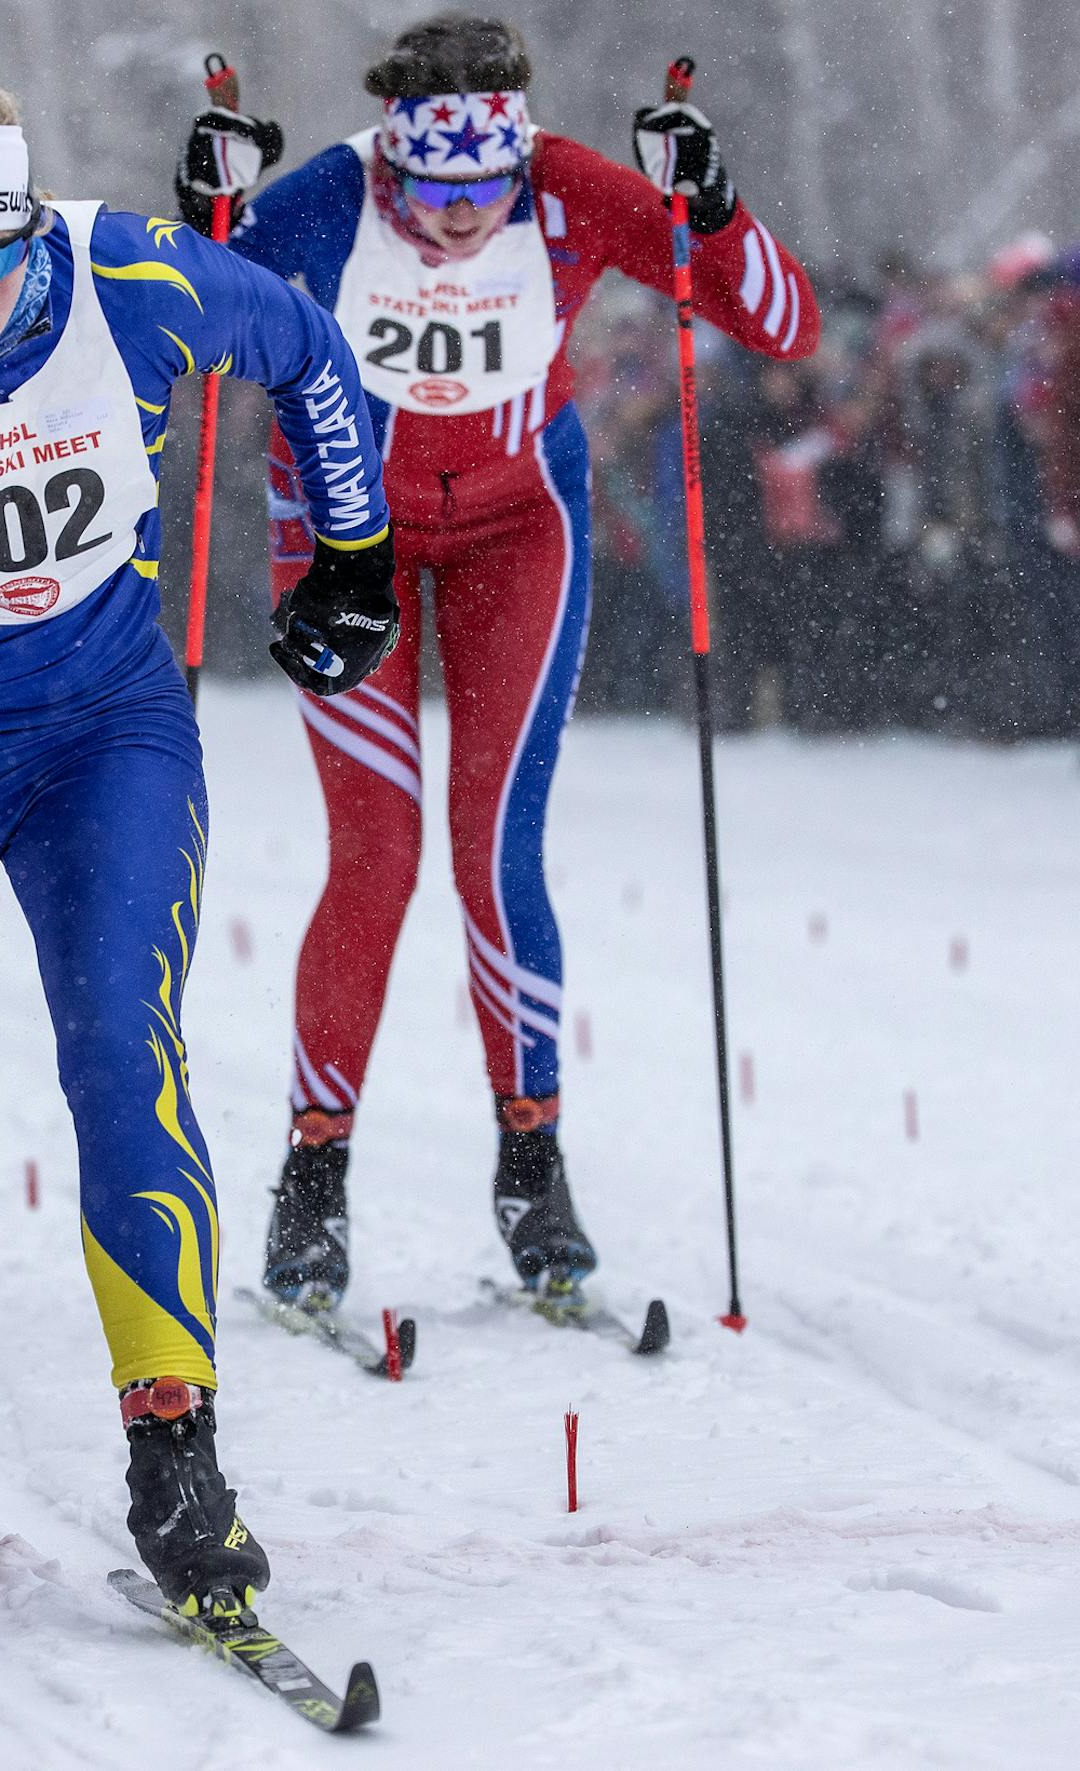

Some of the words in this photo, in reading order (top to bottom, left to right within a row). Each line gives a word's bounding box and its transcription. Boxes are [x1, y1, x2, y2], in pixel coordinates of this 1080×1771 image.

[369, 294, 425, 317] STATE
[466, 294, 517, 315] MEET
[365, 317, 502, 374] 201
[32, 430, 102, 465] MEET
[335, 612, 390, 632] SWIX
